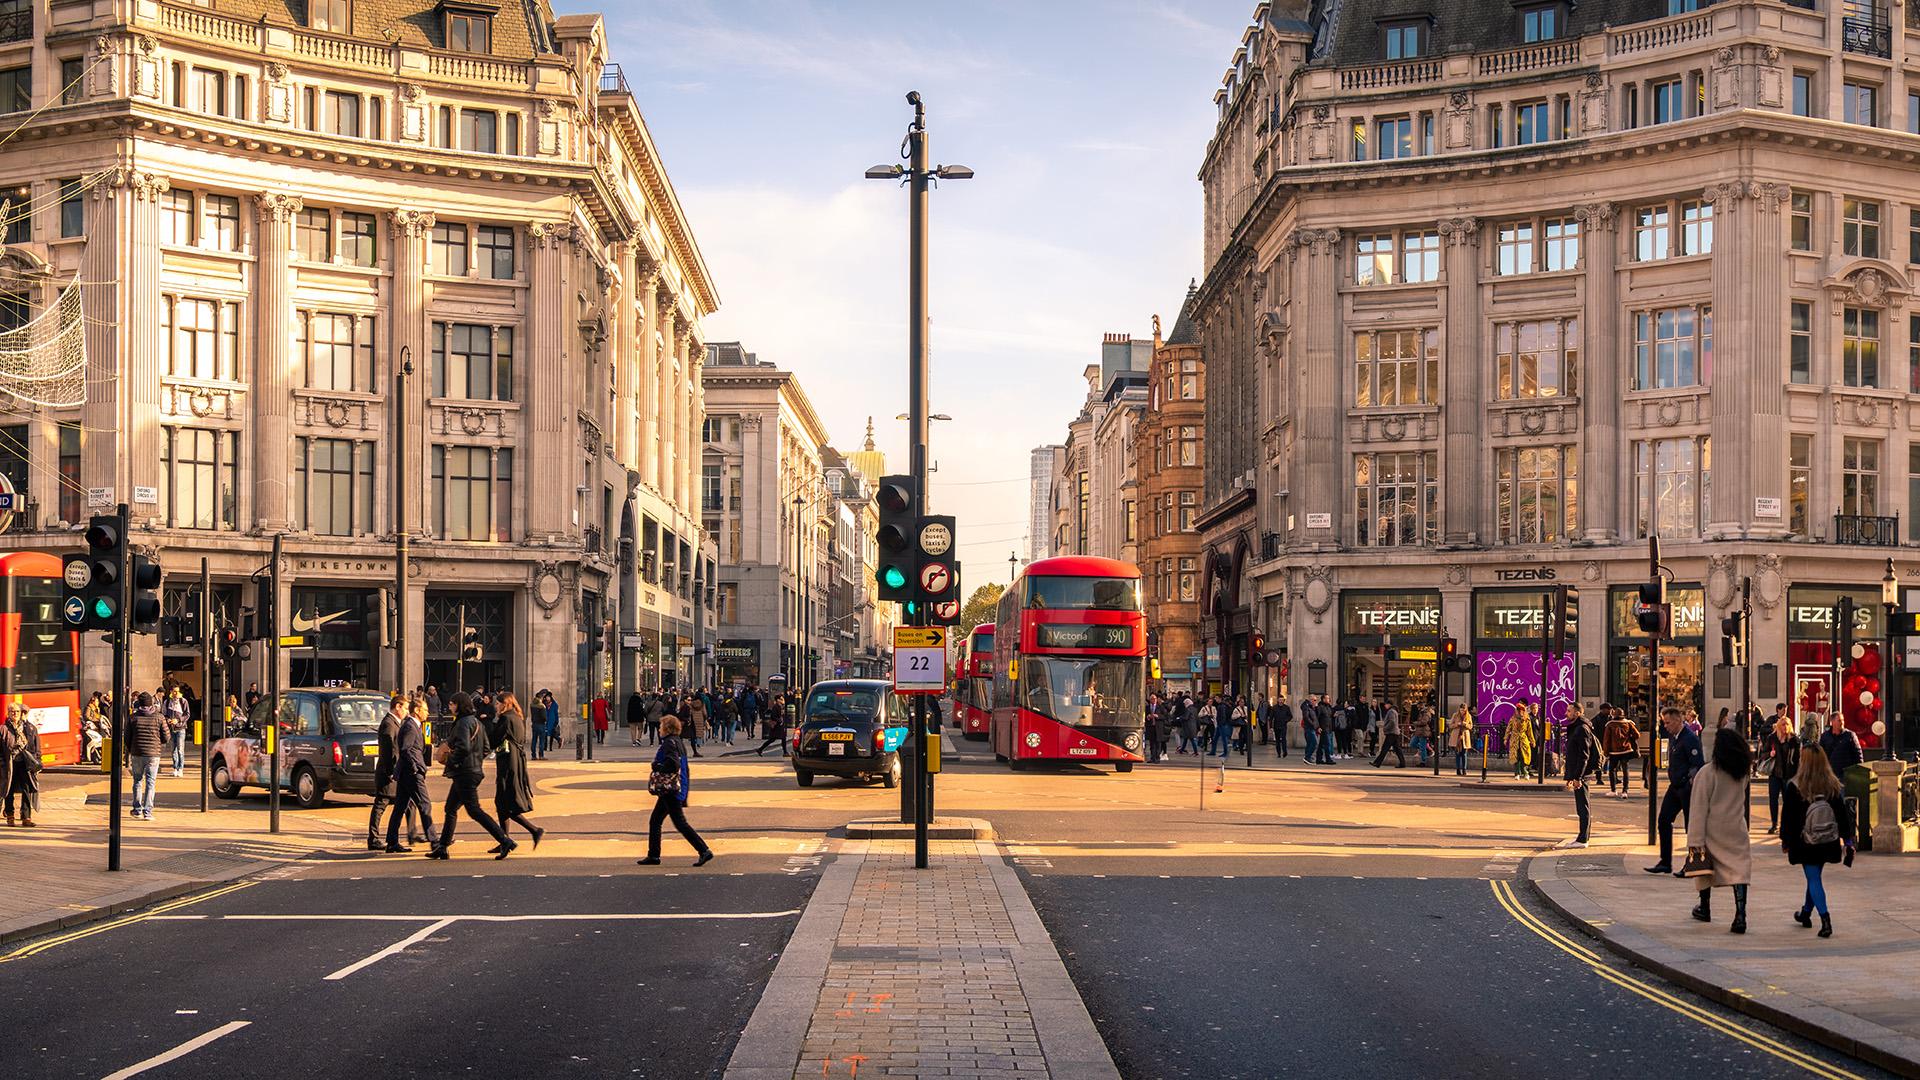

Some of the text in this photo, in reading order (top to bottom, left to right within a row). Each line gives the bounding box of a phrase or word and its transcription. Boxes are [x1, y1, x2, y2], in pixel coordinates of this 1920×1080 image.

[300, 561, 386, 570] NIKETOWN
[1494, 566, 1556, 580] TEZENIS
[42, 605, 50, 619] 7
[1790, 607, 1872, 623] TEZEIS
[1053, 629, 1126, 644] Victoria 390
[910, 656, 929, 670] 22
[1481, 678, 1514, 694] Make
[1529, 665, 1575, 697] wsh
